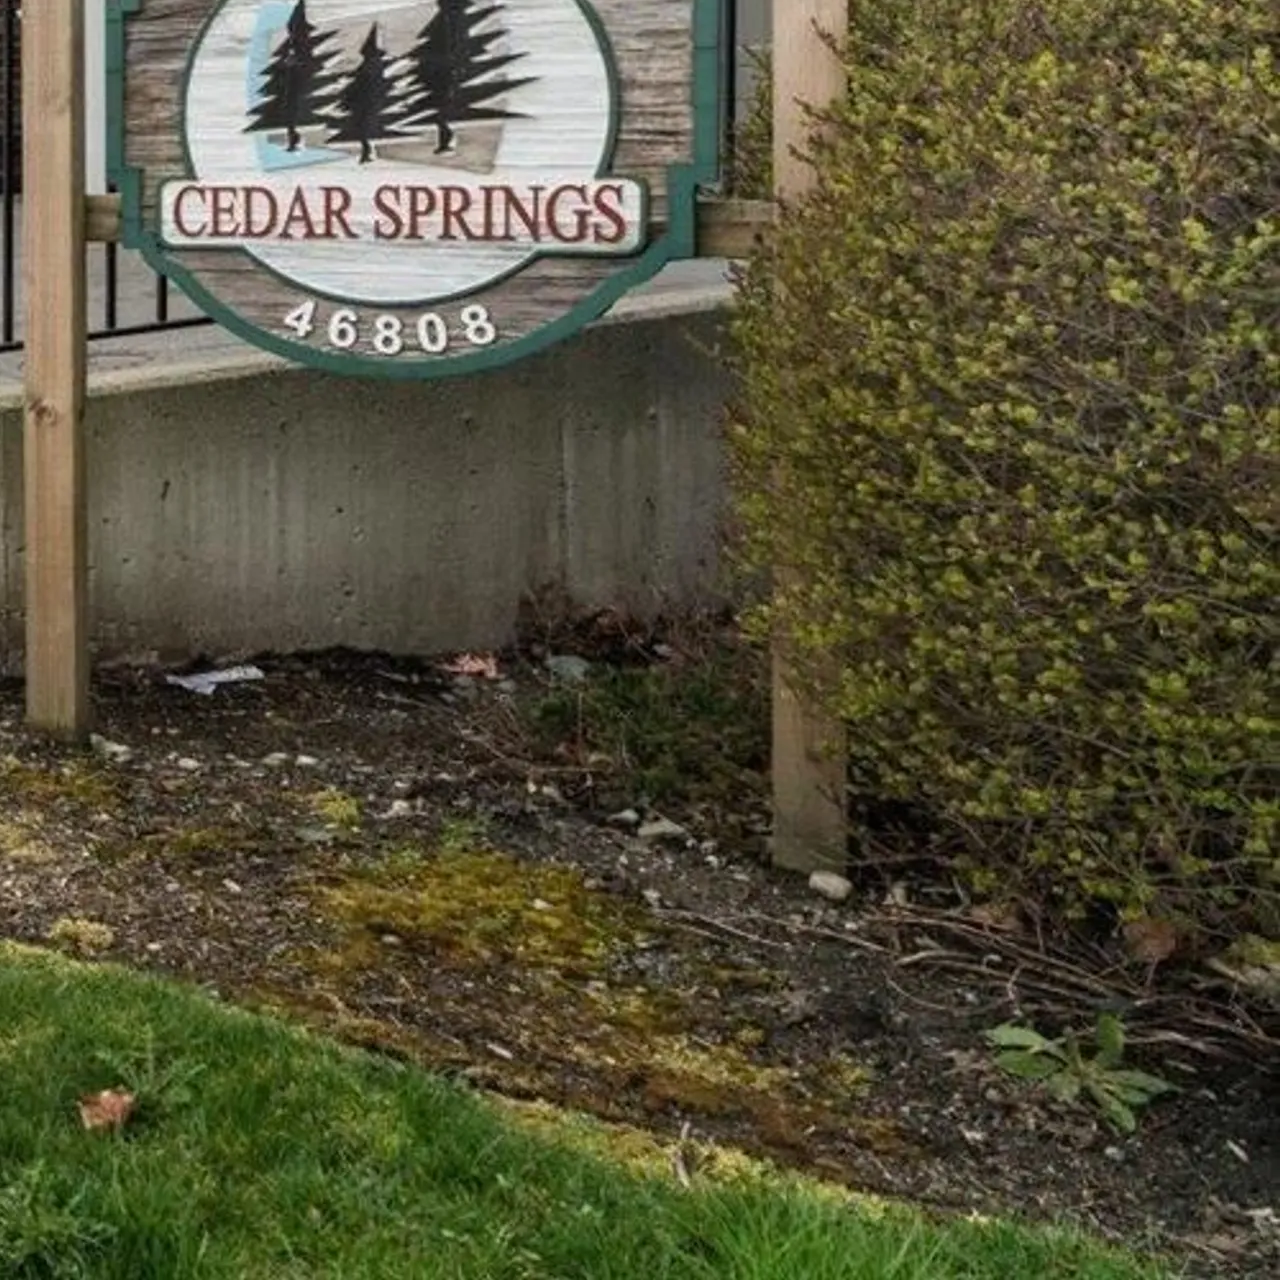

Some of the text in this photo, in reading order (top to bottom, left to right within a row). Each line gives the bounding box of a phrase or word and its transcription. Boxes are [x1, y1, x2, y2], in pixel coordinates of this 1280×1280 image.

[173, 184, 626, 243] CEDAR SPRINGS
[285, 300, 496, 354] 46808
